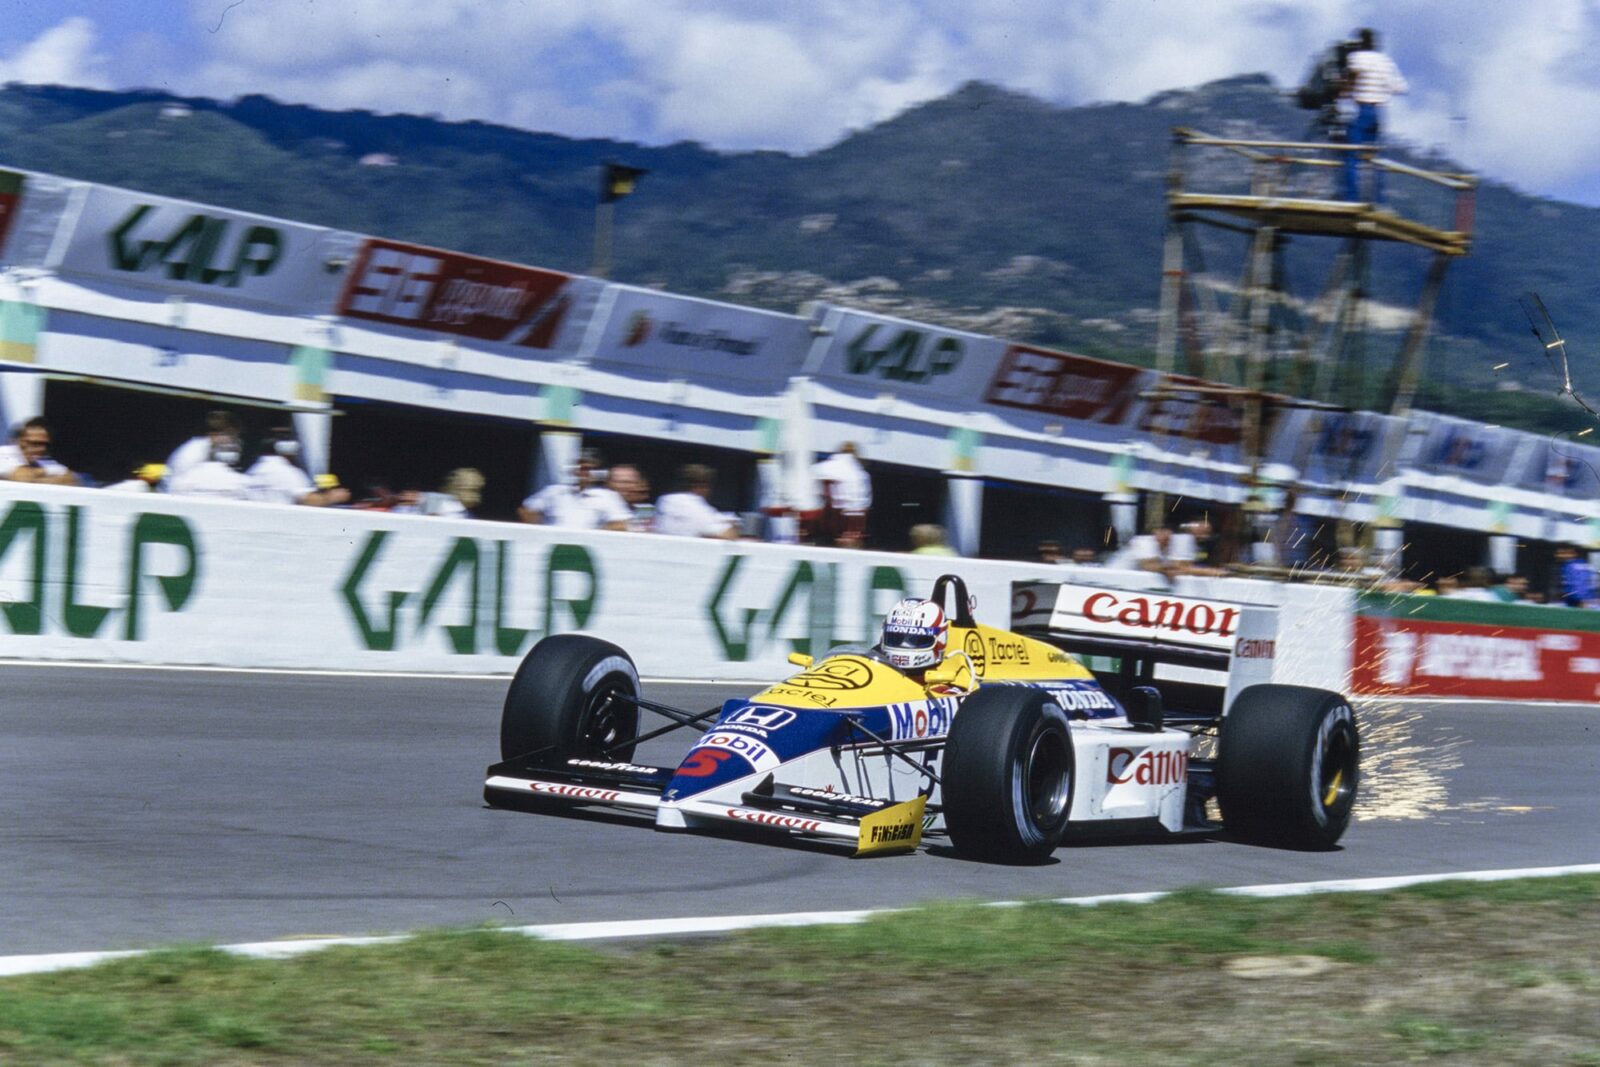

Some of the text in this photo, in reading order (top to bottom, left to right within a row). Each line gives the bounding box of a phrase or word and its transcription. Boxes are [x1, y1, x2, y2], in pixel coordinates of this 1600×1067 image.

[107, 204, 285, 288] GALP
[843, 323, 966, 384] GALP
[337, 530, 598, 656] GALP
[886, 625, 926, 635] HONDA
[891, 616, 912, 625] Mobil
[989, 637, 1031, 664] Tactel
[759, 688, 838, 708] actel
[892, 696, 953, 740] Mobil
[714, 724, 768, 738] HONDA
[567, 758, 659, 774] GOODYEAR
[673, 747, 732, 777] 5
[529, 782, 620, 801] Canon
[789, 786, 885, 807] GOODYEAR
[726, 808, 822, 831] Canon
